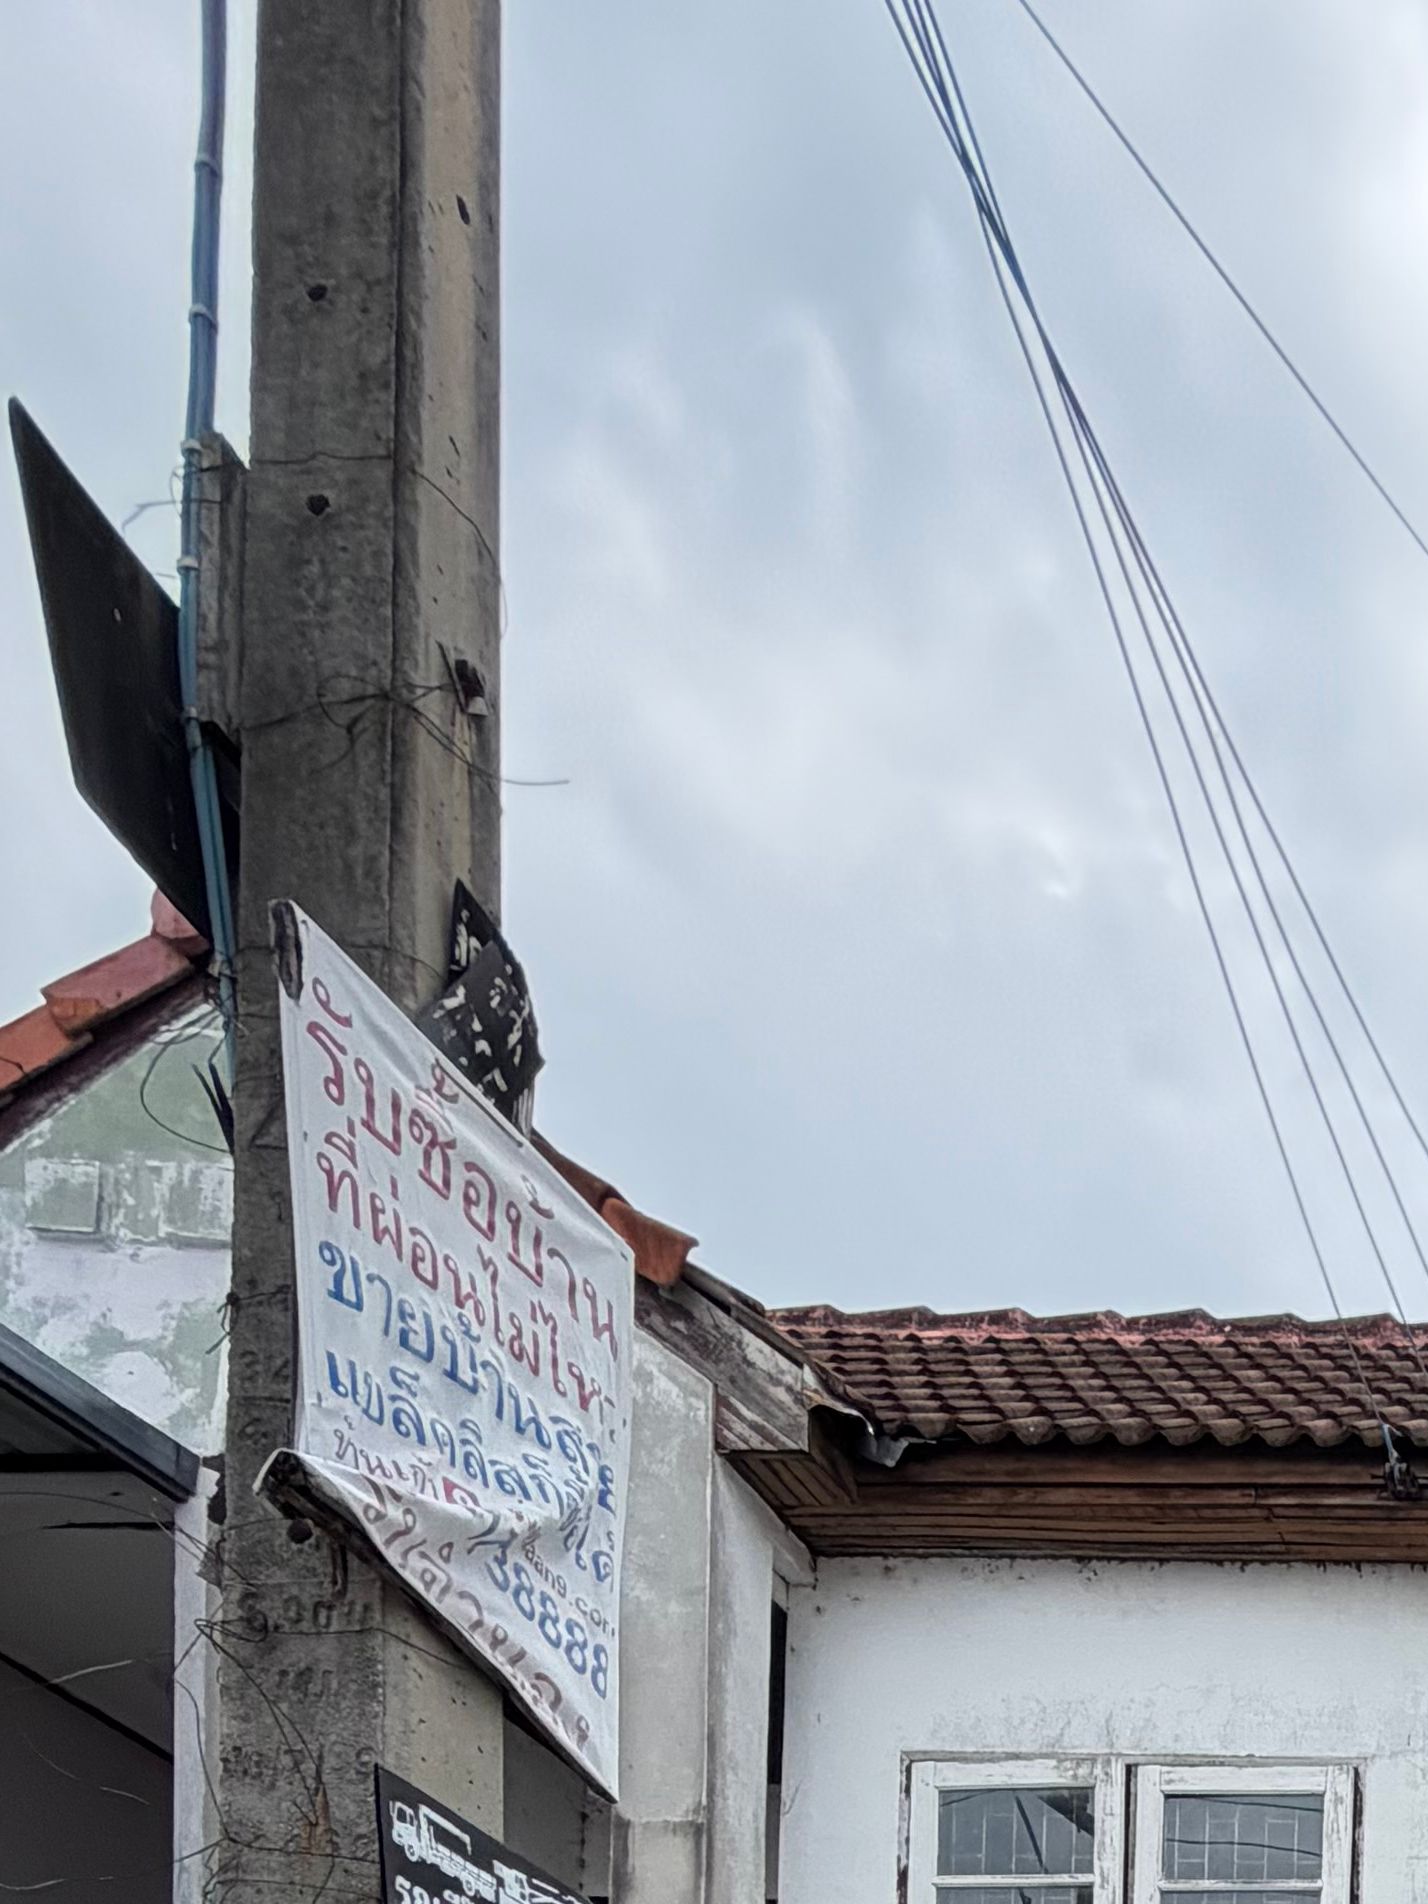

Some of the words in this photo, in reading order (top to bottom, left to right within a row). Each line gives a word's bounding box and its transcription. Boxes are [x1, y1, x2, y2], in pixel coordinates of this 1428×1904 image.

[307, 976, 618, 1362] รับซื้อบ้าน
